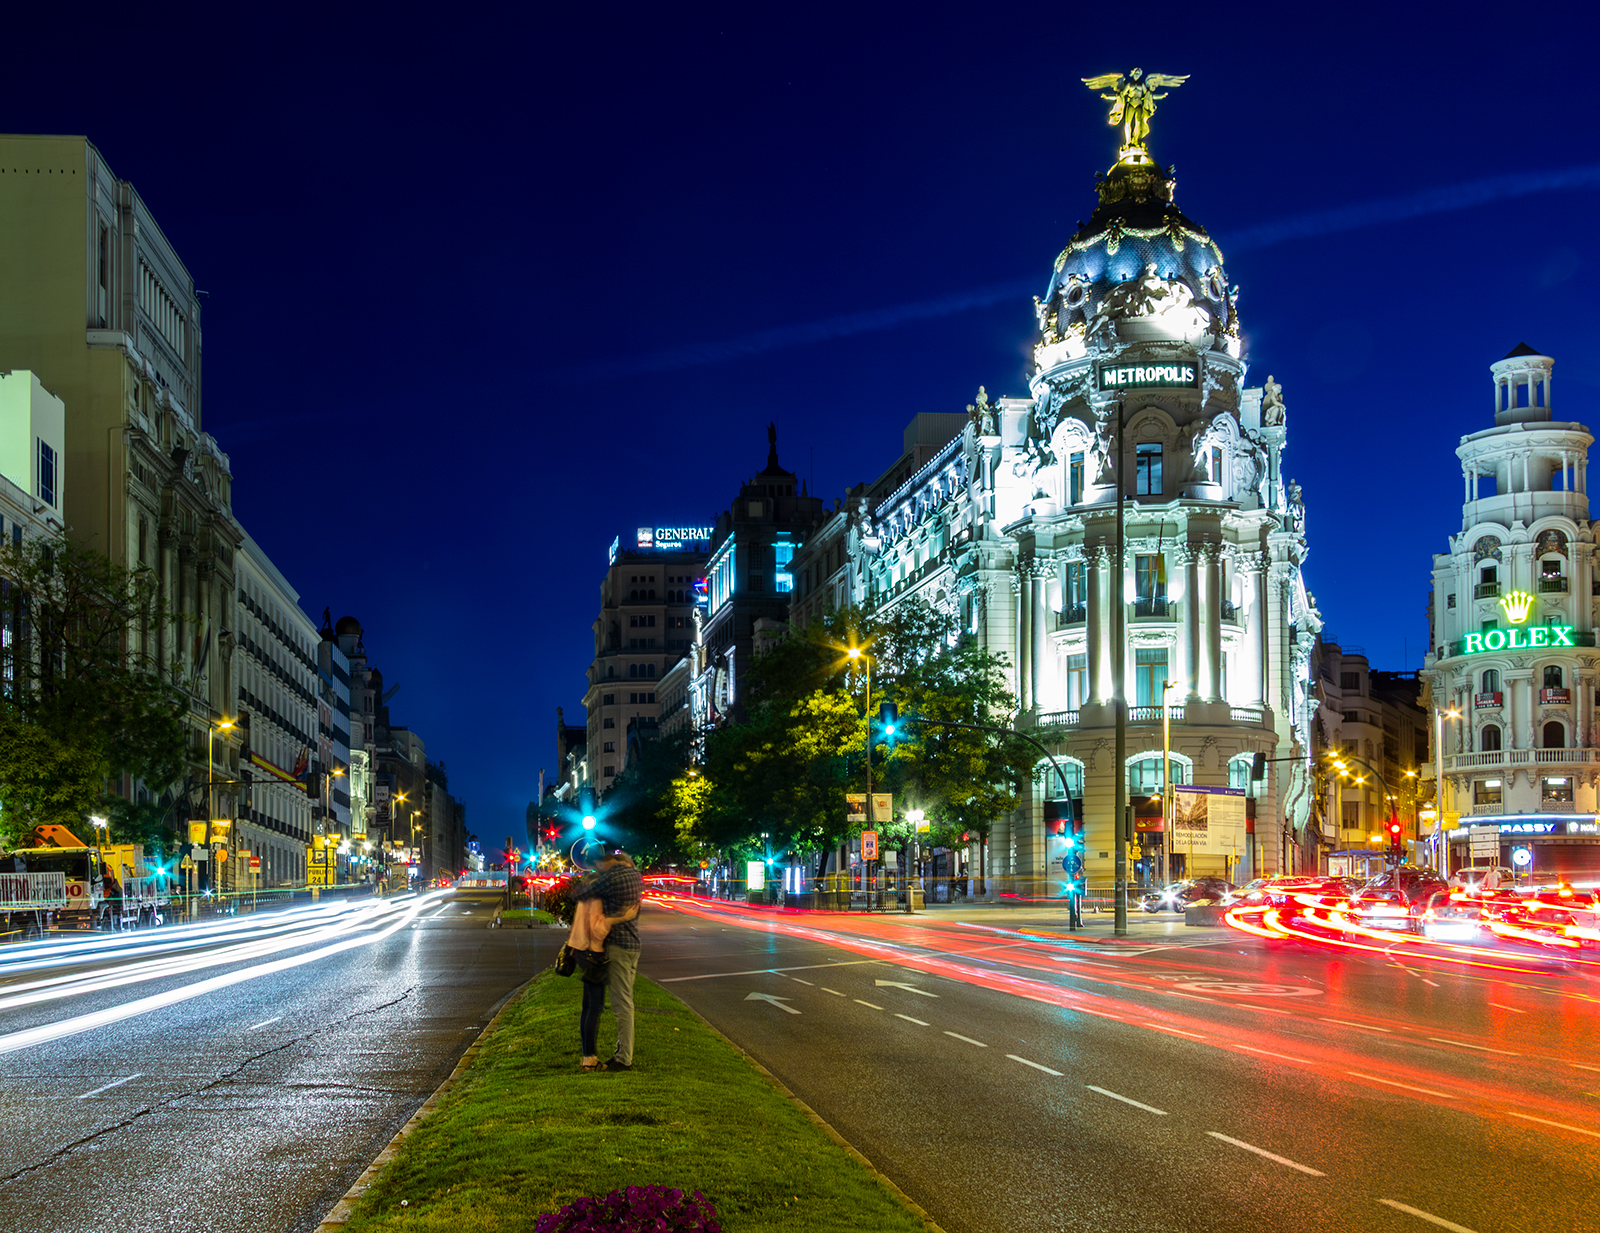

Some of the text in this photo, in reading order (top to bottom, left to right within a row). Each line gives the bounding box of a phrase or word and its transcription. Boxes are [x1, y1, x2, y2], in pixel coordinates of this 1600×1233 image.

[1104, 366, 1195, 385] METROPOLIS
[655, 540, 682, 549] Seguros
[1464, 627, 1574, 653] ROLEX
[1499, 823, 1556, 833] RASSY
[315, 851, 324, 862] P
